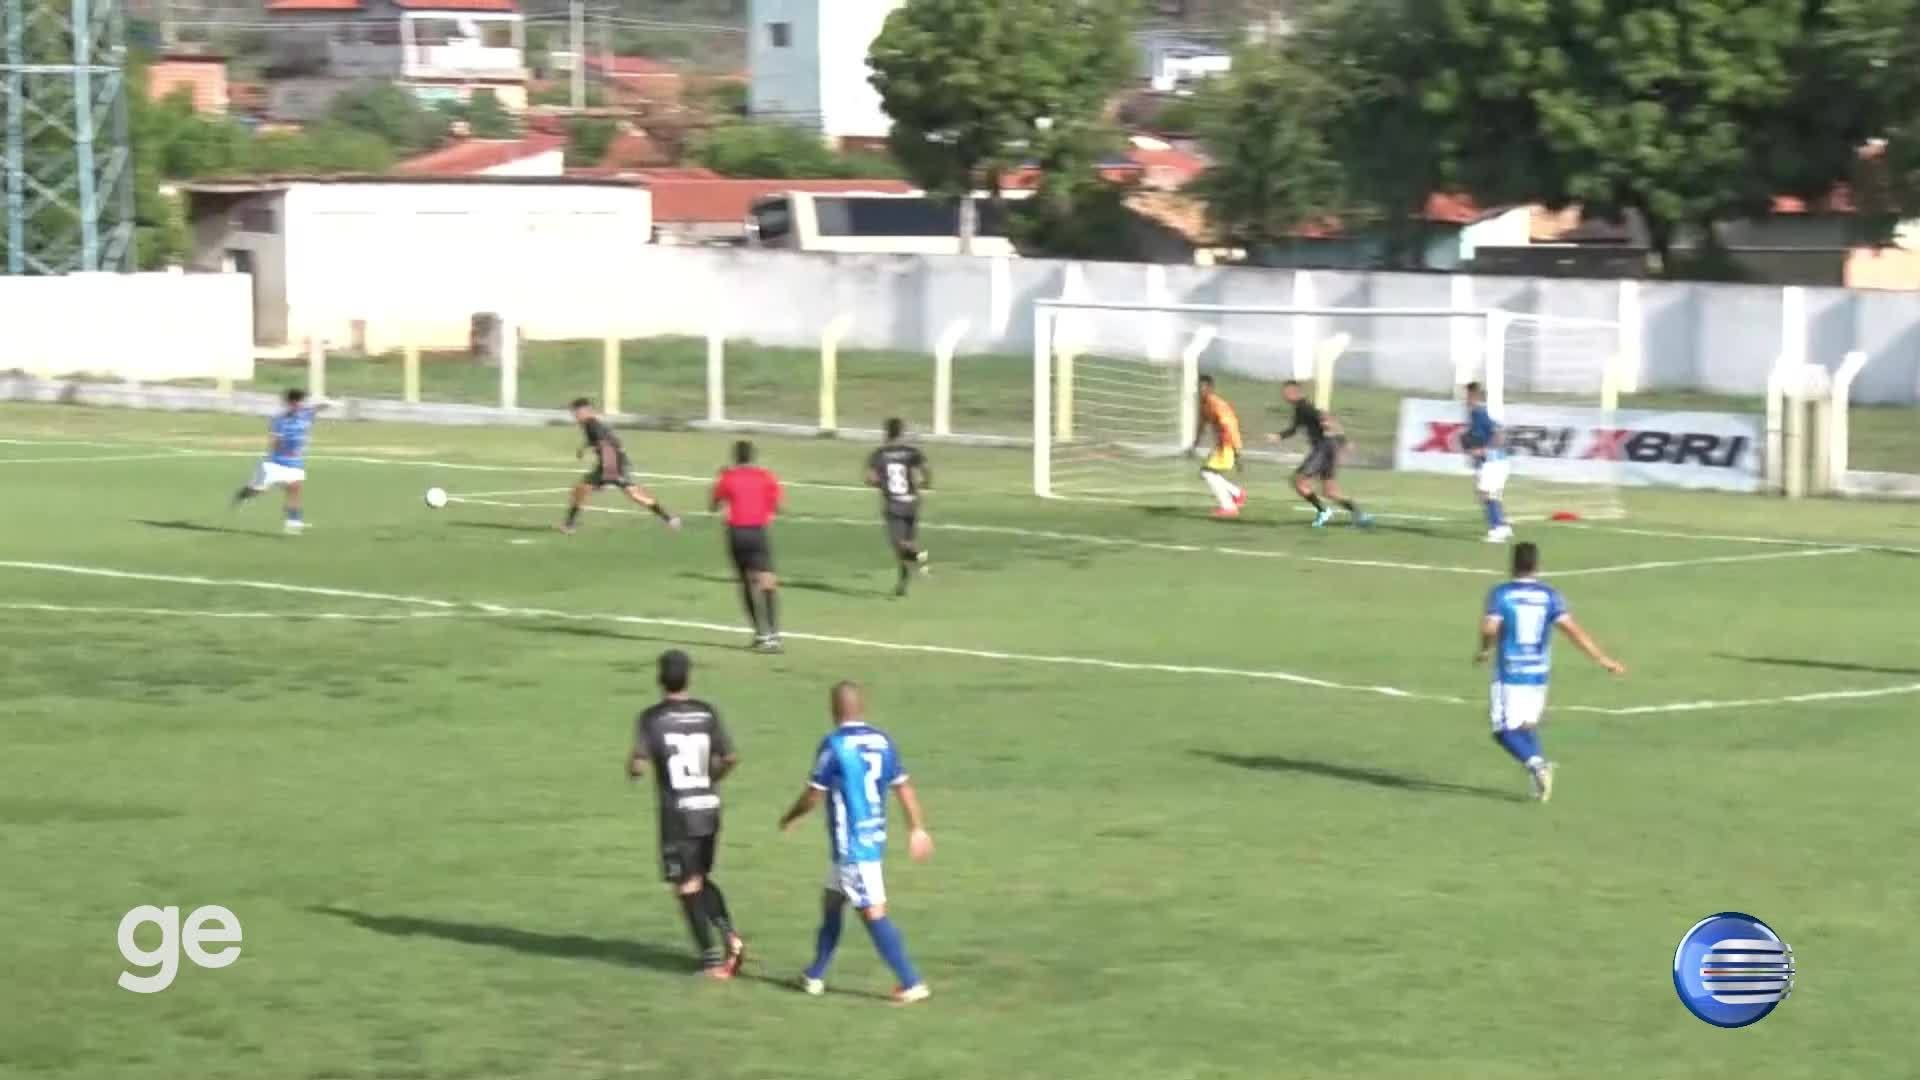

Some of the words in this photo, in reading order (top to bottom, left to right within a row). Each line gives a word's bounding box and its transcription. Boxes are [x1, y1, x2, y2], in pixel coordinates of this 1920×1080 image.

[1580, 428, 1748, 467] XBRI
[663, 732, 712, 790] 20
[859, 750, 883, 804] 7
